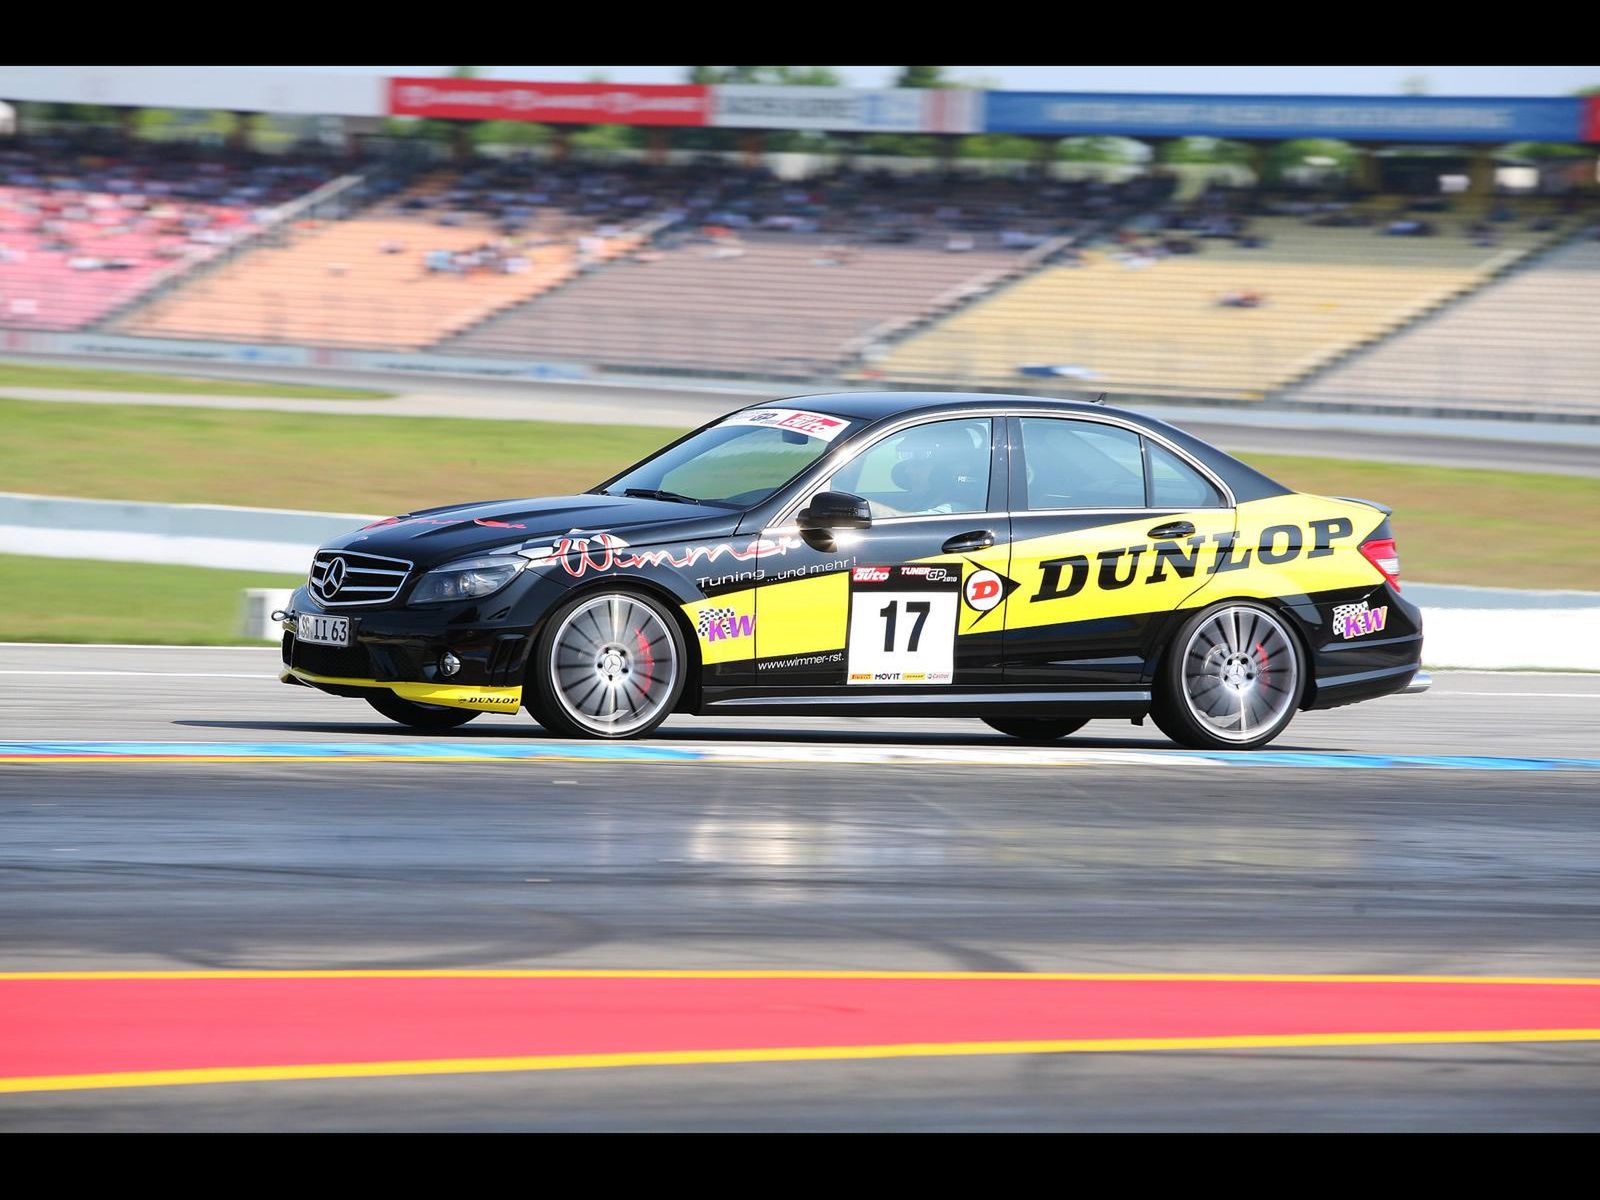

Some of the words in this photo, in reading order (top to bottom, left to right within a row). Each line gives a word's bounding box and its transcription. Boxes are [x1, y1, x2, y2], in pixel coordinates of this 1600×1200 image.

[542, 534, 802, 577] Wimmer
[1030, 517, 1354, 603] DUNLOP
[696, 569, 765, 588] Tuning
[853, 572, 890, 581] auto
[901, 567, 930, 575] TUNER
[926, 568, 947, 580] GP
[971, 580, 999, 601] D
[332, 620, 347, 641] 63
[708, 614, 756, 642] KW
[880, 600, 931, 652] 17
[1343, 605, 1388, 639] KW
[758, 653, 844, 671] www.wimmer-rst.
